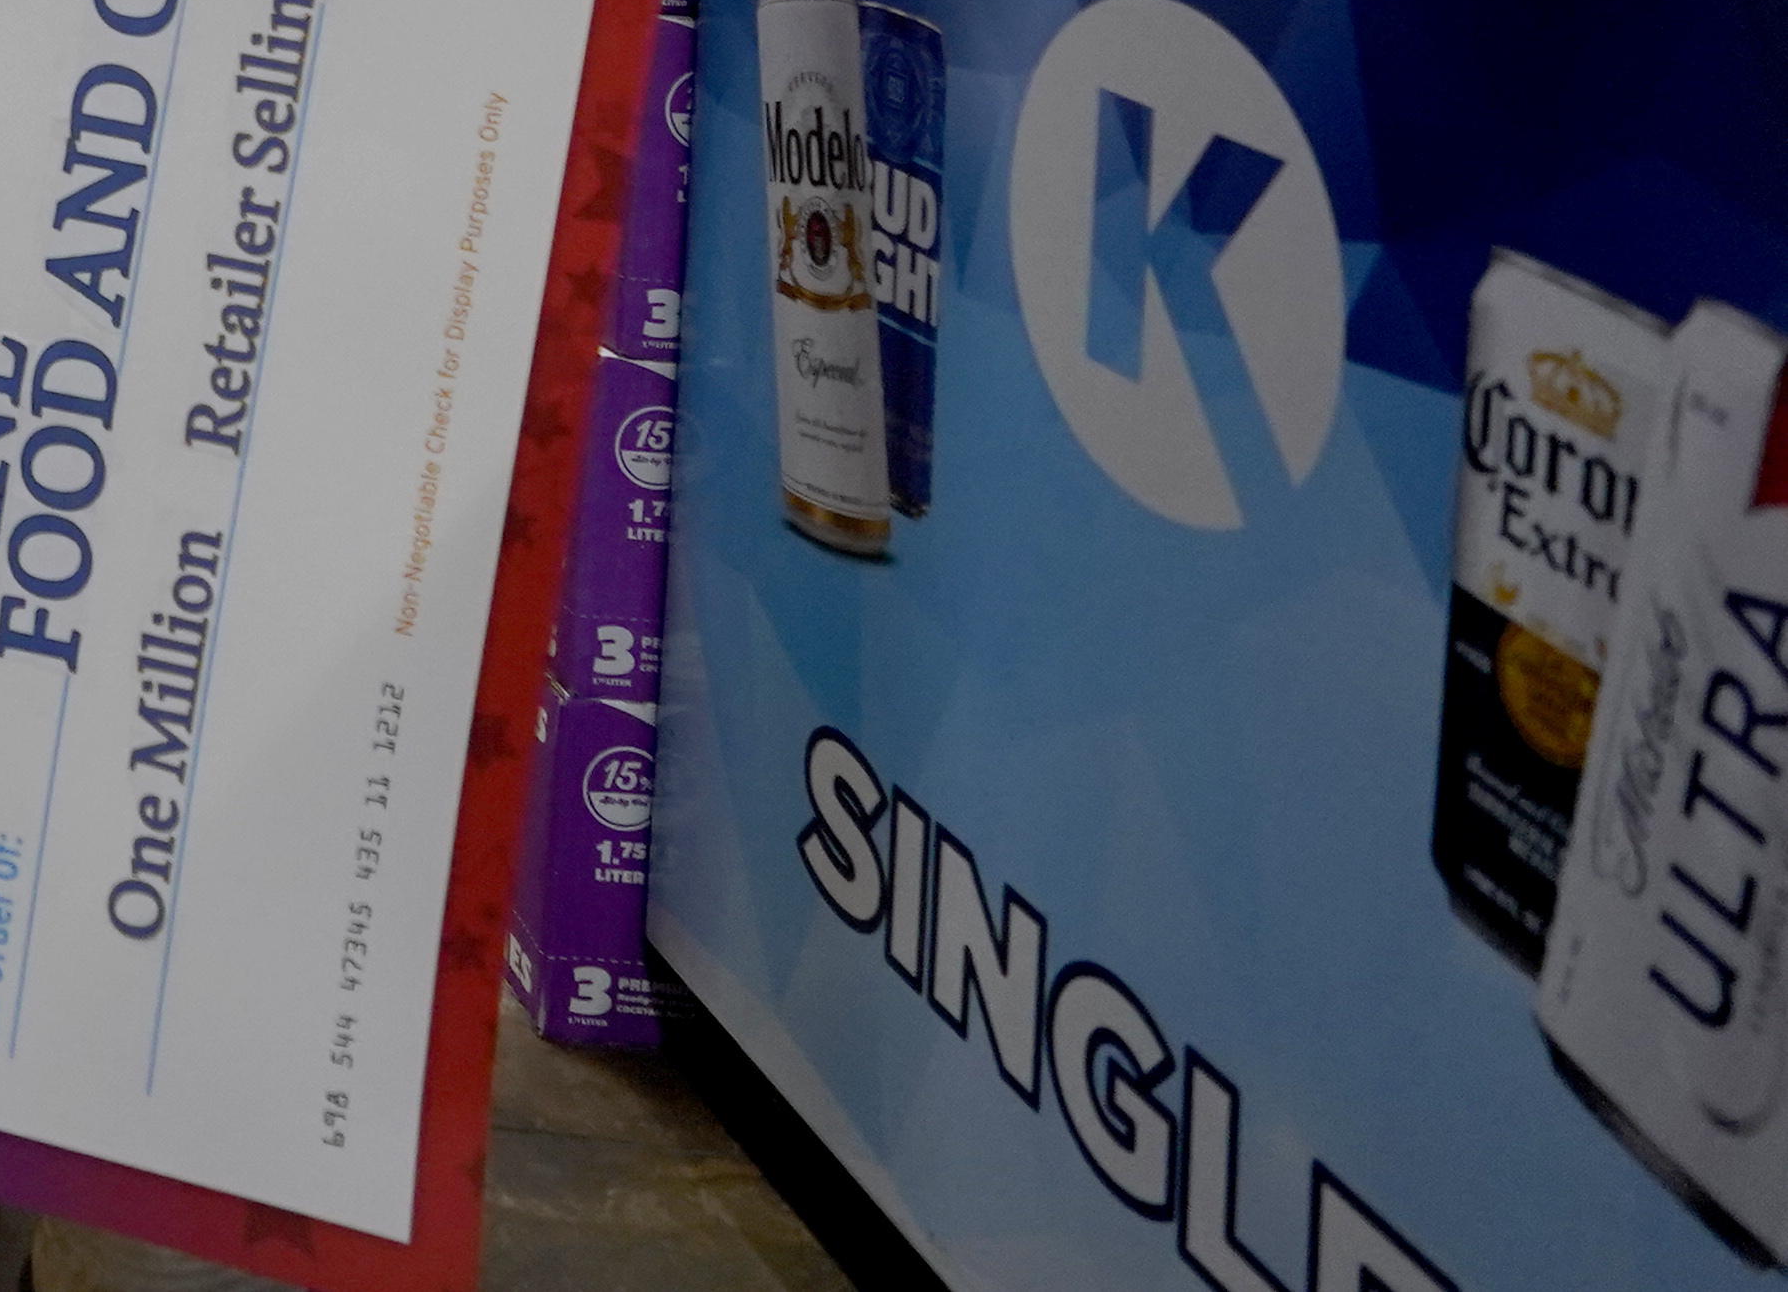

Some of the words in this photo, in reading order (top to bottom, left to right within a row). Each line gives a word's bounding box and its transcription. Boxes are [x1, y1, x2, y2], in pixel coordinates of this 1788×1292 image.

[479, 93, 509, 142] Only
[765, 101, 869, 193] Modelo
[45, 62, 161, 327] AND
[461, 149, 497, 255] Purposes
[185, 187, 281, 457] Retailer
[445, 260, 479, 341] Display
[644, 289, 681, 339] 3
[1085, 87, 1288, 530] K
[438, 348, 460, 380] for
[425, 388, 452, 455] Check
[396, 461, 442, 638] Non-Negotiable
[127, 529, 224, 789] Million
[592, 625, 635, 676] 3
[373, 683, 405, 755] 1212
[365, 777, 390, 809] 11
[1647, 589, 1788, 1030] ULTRA
[106, 795, 179, 942] One
[356, 829, 382, 880] 435
[594, 868, 646, 884] LITER
[595, 840, 647, 865] 1.75
[341, 902, 373, 991] 47345
[569, 966, 613, 1015] 3
[332, 1014, 356, 1069] 544
[324, 1090, 350, 1148] 698
